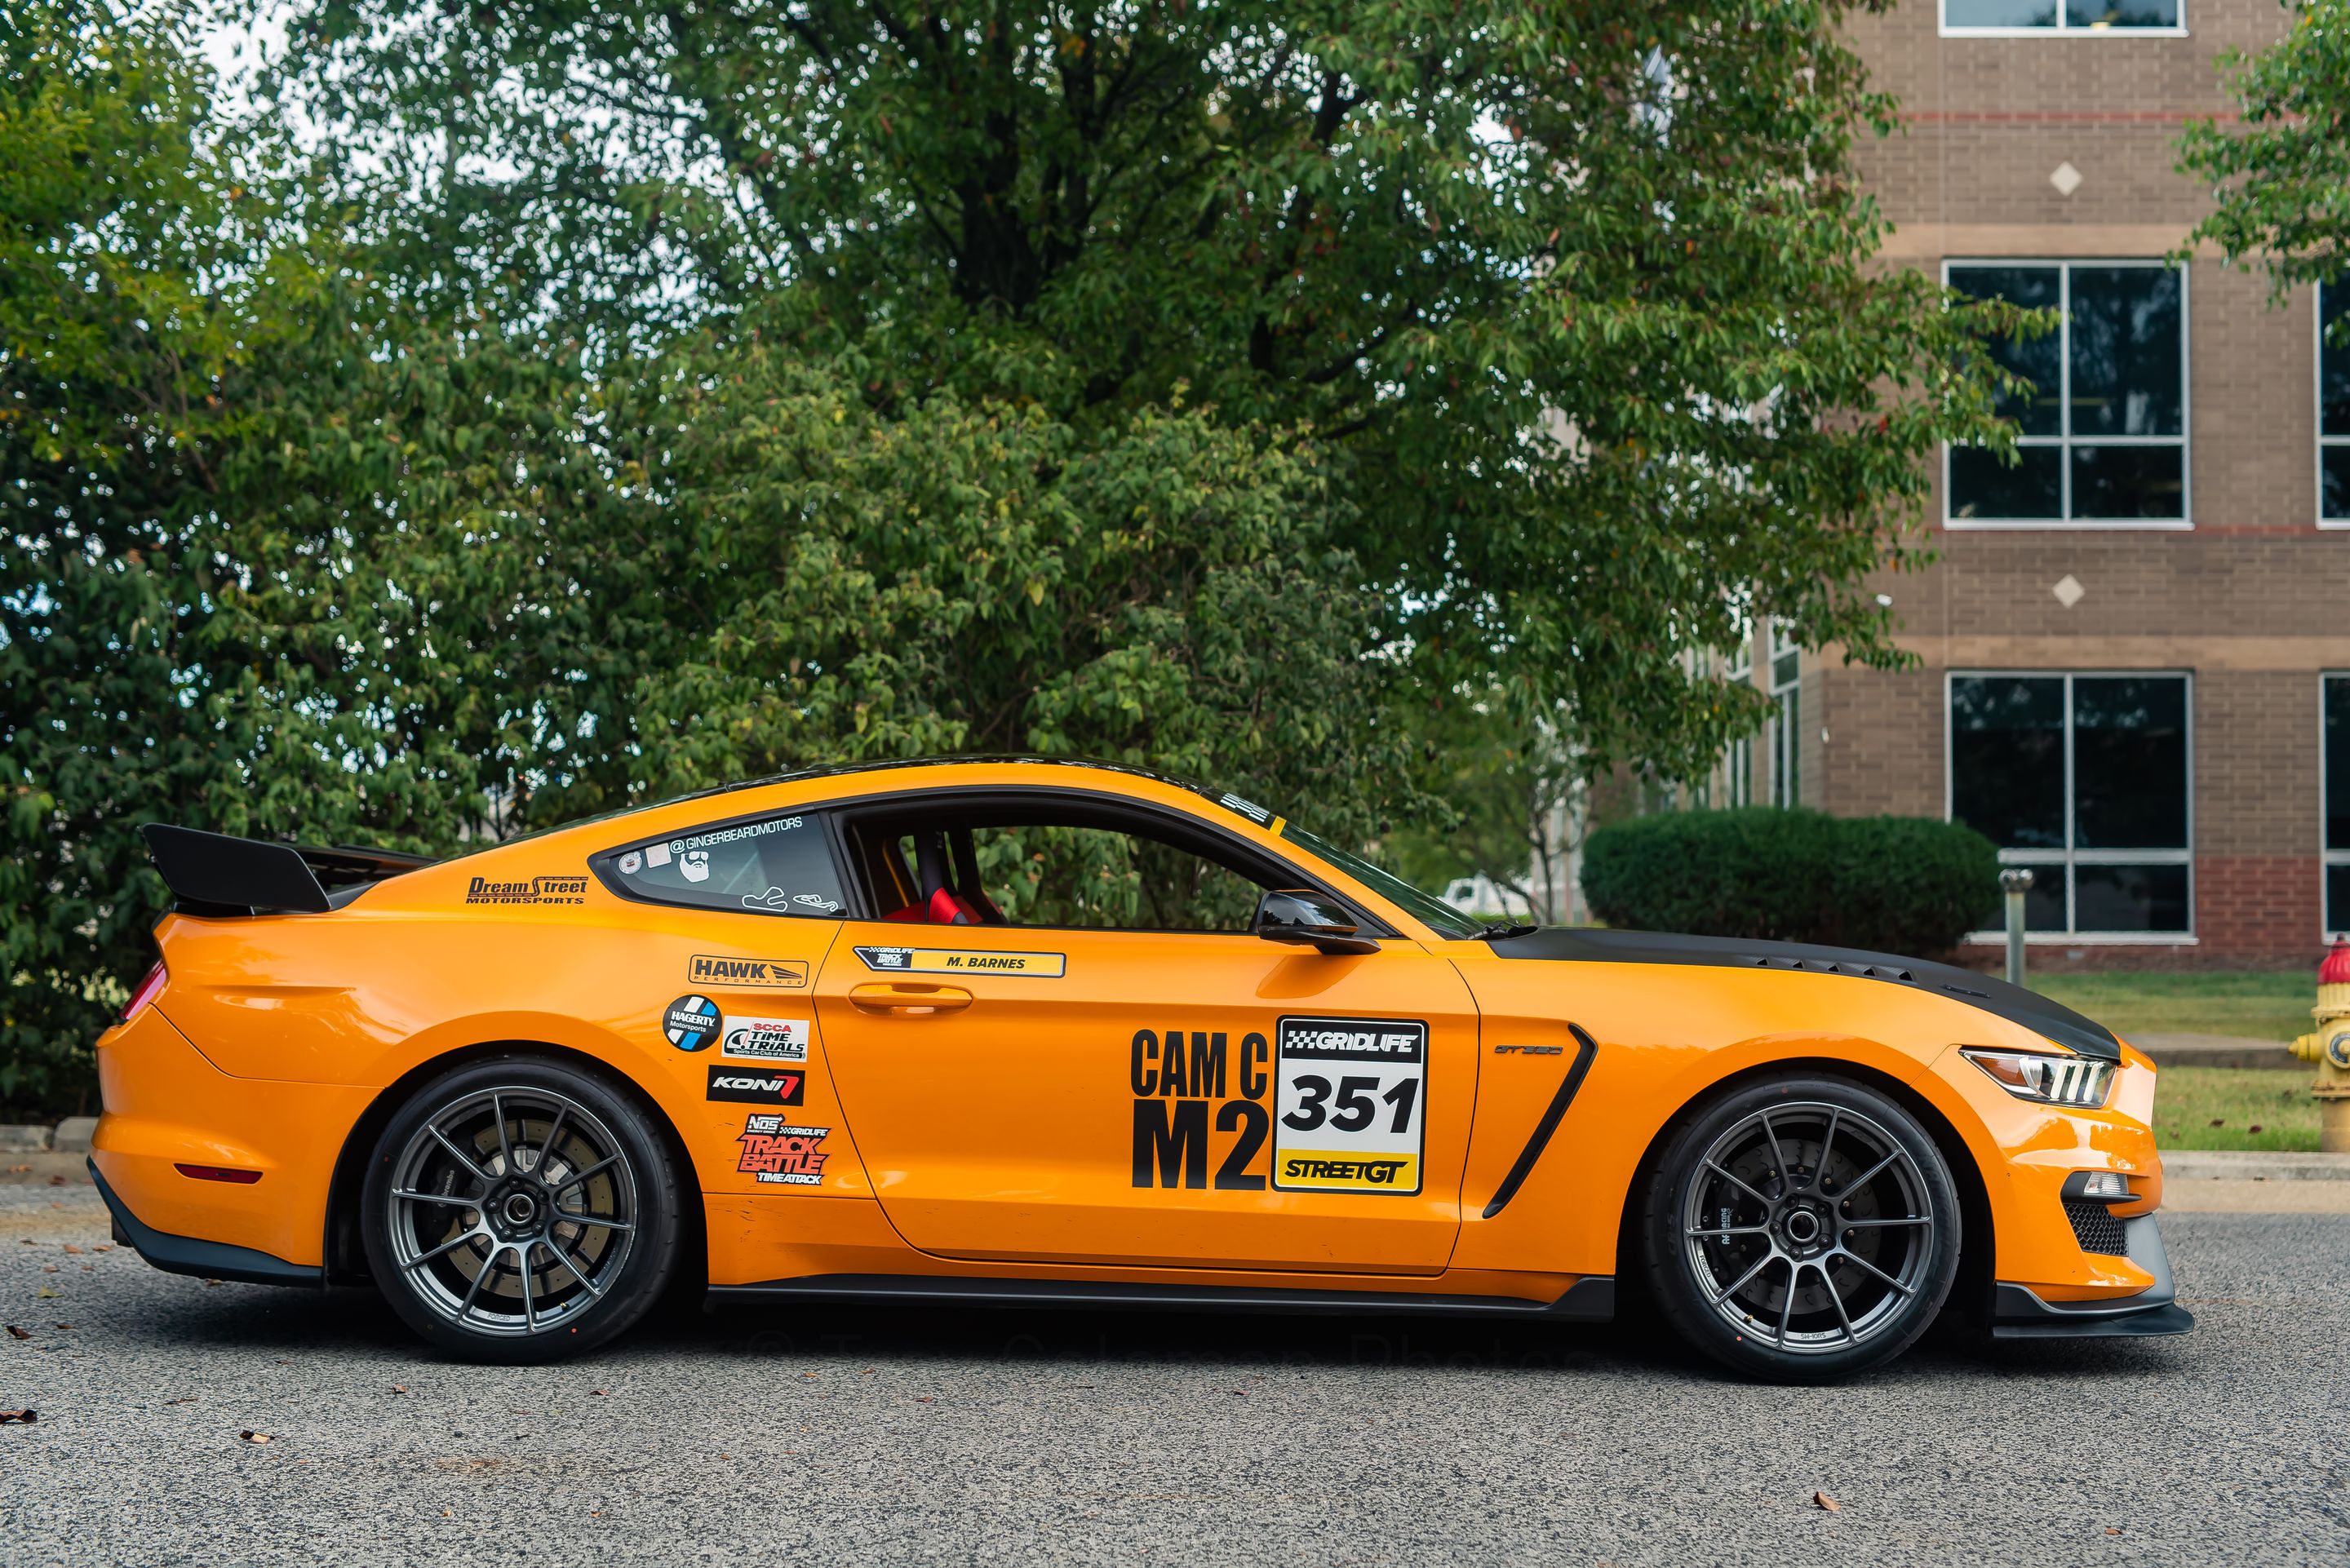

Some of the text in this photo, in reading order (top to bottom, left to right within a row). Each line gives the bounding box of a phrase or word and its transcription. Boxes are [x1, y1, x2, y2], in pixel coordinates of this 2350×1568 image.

[670, 816, 803, 853] @GINGERBEARDMOTORS
[695, 959, 767, 979] HAWK
[947, 956, 1026, 969] M. BARNES
[694, 976, 802, 986] PERFORMANCE
[669, 1020, 707, 1033] Motorsports
[671, 1011, 716, 1027] HAGERTY
[753, 1022, 792, 1033] SCCA
[1315, 1030, 1419, 1053] GRIDLIFE
[1130, 1029, 1269, 1101] CAM C
[712, 1077, 784, 1092] KONI
[1280, 1074, 1420, 1134] 351
[747, 1115, 781, 1130] NOS
[740, 1135, 822, 1154] TRACK
[1132, 1099, 1270, 1191] M2
[738, 1154, 826, 1175] BATTLE
[1700, 1255, 1712, 1278] FORGED
